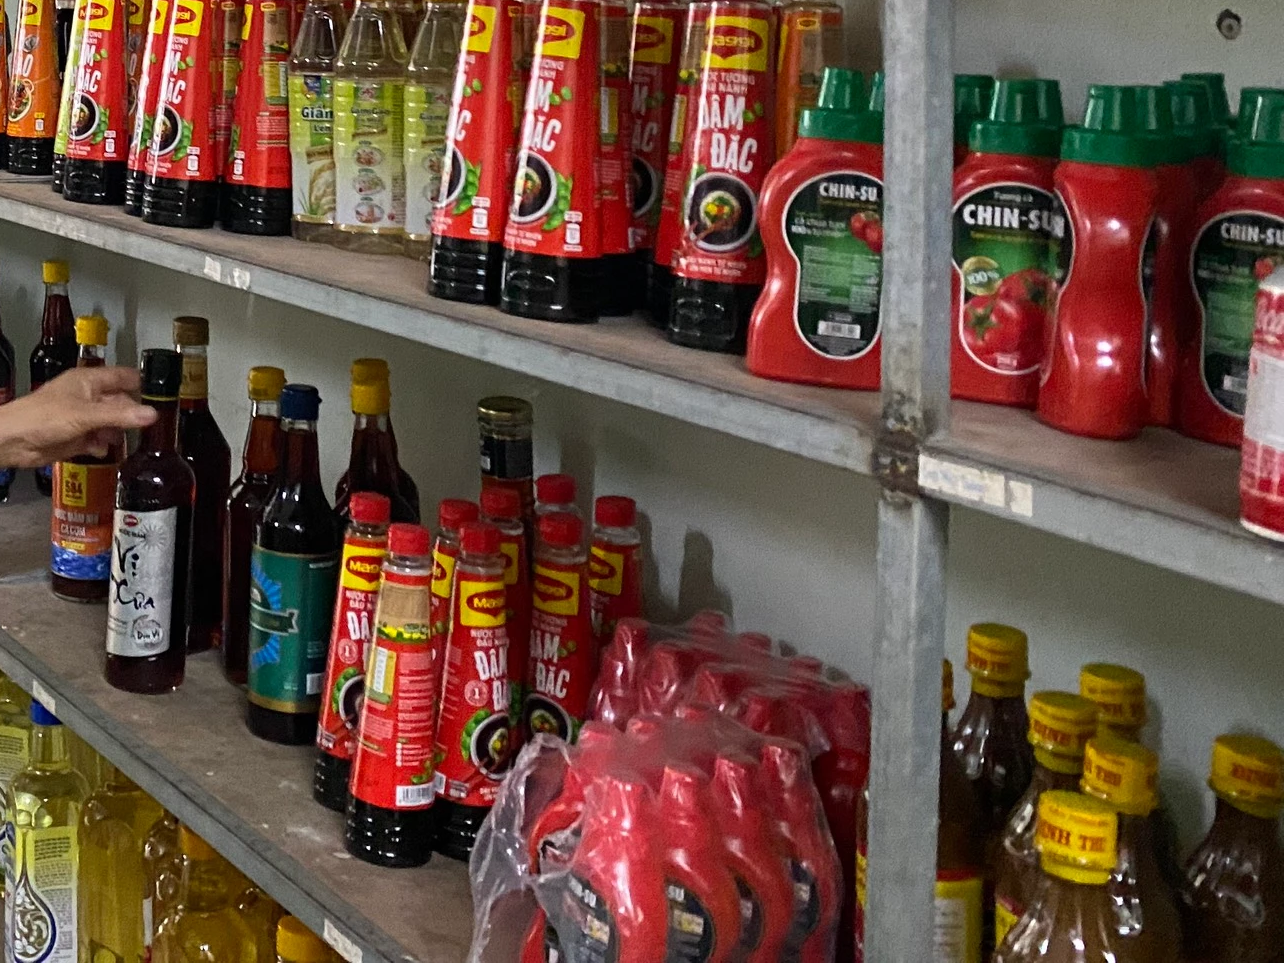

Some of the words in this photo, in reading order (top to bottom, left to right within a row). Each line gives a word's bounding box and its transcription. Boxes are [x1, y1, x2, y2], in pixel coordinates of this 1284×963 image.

[711, 133, 757, 174] ĐẶC
[819, 182, 878, 202] CHIN-SU
[967, 271, 1000, 285] 100%
[66, 481, 83, 495] 584
[349, 560, 380, 573] Mag
